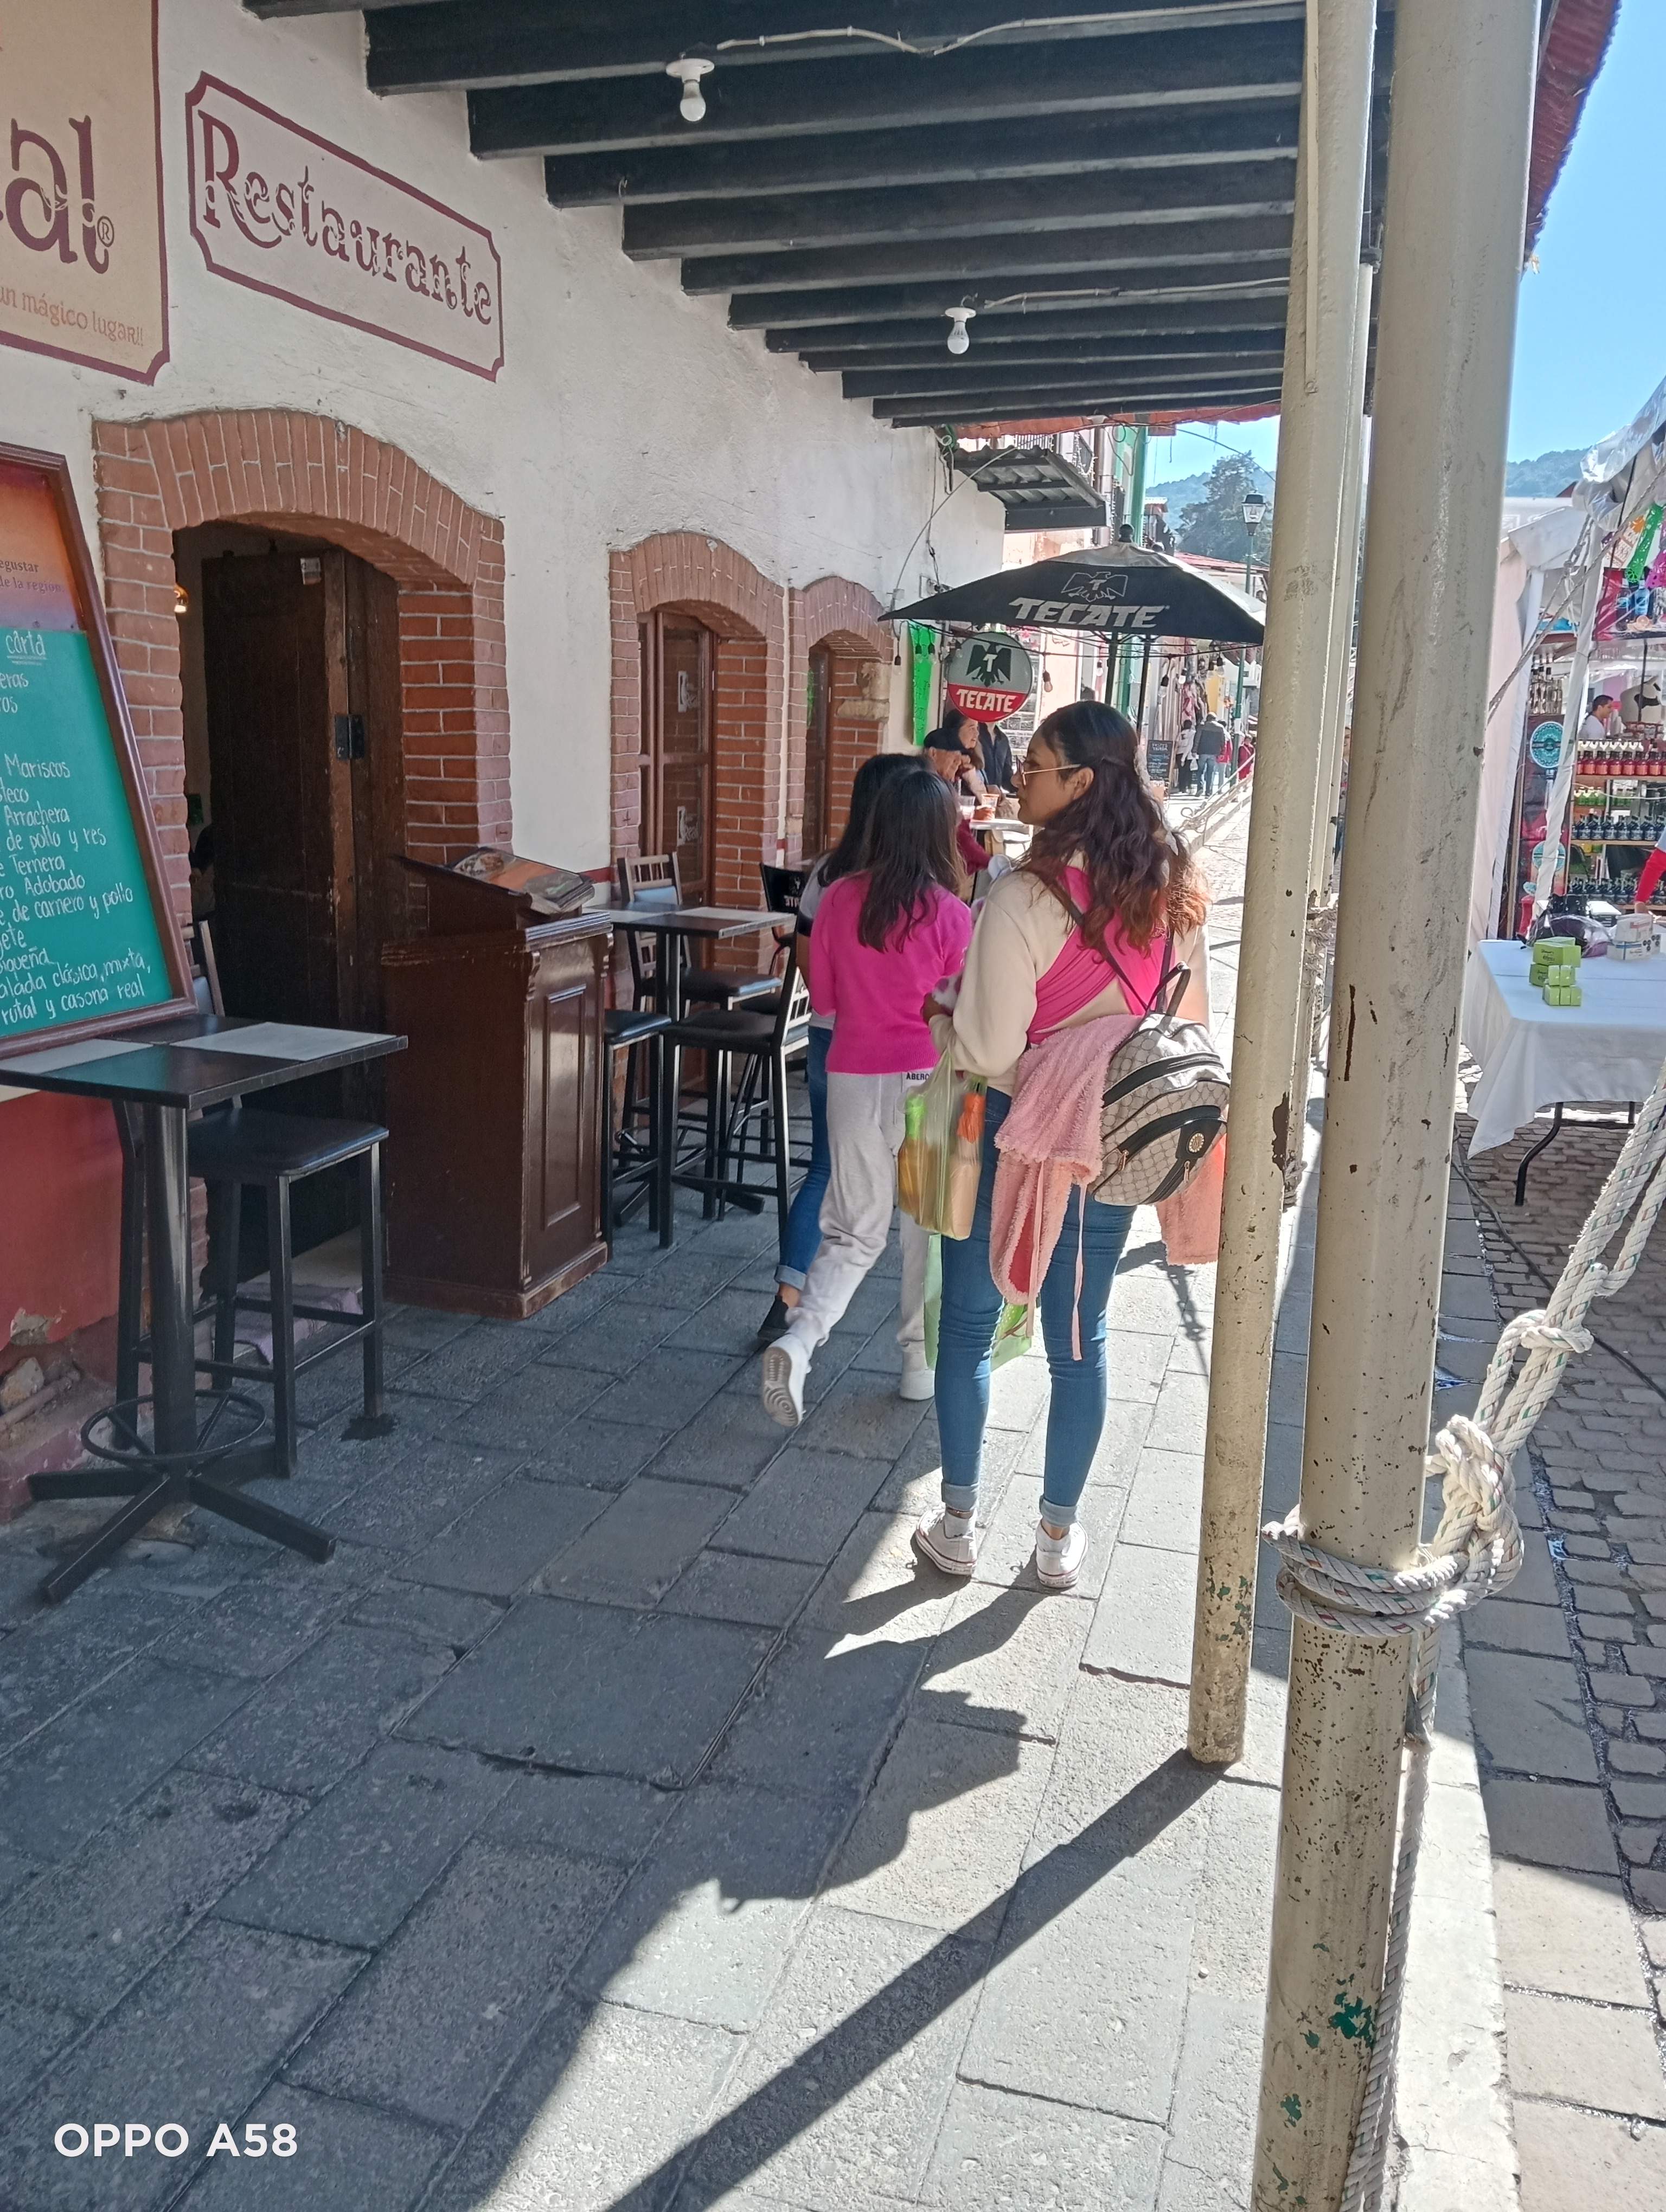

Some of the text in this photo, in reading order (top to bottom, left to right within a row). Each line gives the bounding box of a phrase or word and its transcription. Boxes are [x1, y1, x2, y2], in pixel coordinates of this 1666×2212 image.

[0, 114, 110, 274] al
[197, 110, 492, 325] Restaurante
[22, 293, 88, 330] mágico
[12, 577, 23, 588] la
[1009, 597, 1165, 628] TECATE
[6, 631, 46, 655] carta
[956, 689, 1017, 712] TECATE
[4, 753, 71, 778] Mariscos
[4, 801, 70, 826] Arrachera
[7, 825, 106, 855] de pollo y res
[9, 854, 65, 876] Ternera
[24, 869, 85, 896] Adobado
[12, 899, 30, 922] de
[34, 896, 84, 919] carnero
[89, 896, 99, 919] y
[102, 882, 133, 914] pollo
[46, 999, 56, 1020] y
[61, 987, 109, 1012] casona
[117, 973, 145, 999] real
